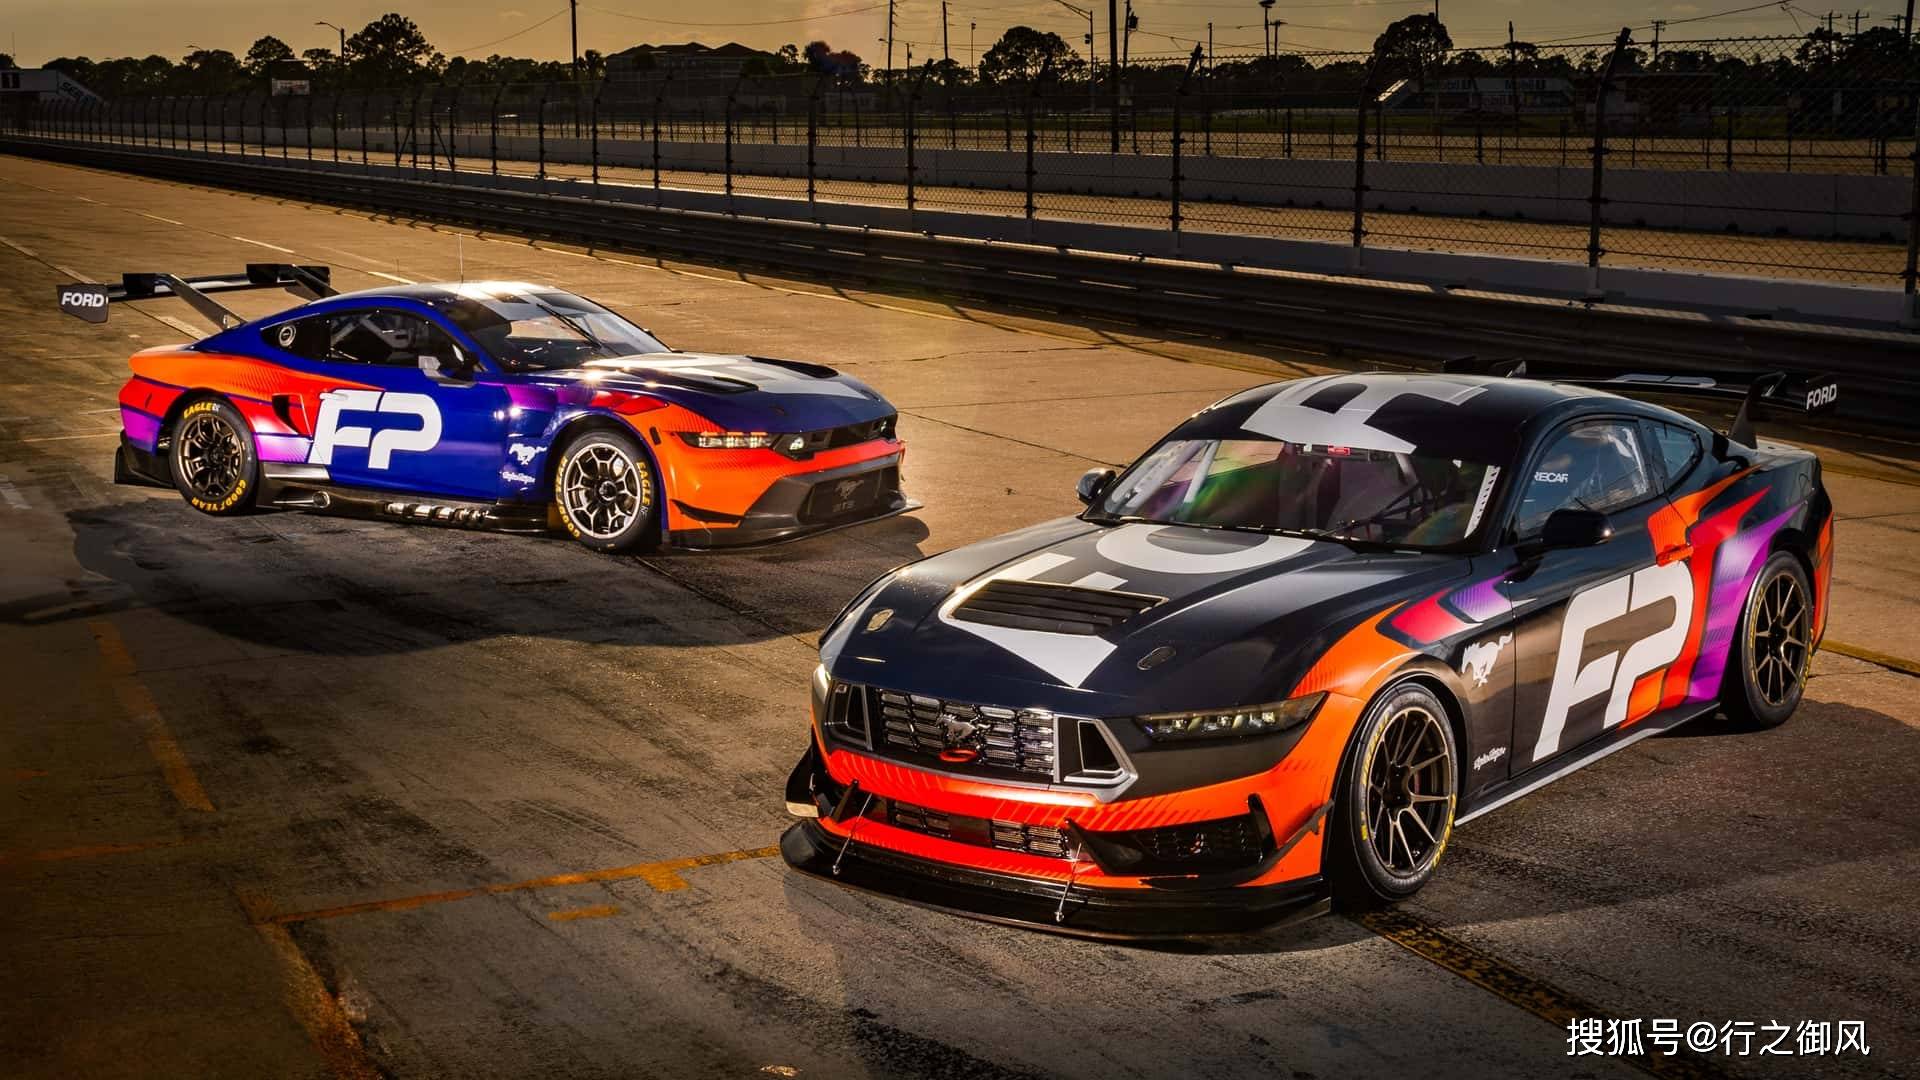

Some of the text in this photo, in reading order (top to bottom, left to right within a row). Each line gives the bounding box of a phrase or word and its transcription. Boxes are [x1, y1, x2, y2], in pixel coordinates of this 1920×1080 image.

[61, 292, 104, 307] FORD
[1806, 383, 1837, 410] FORD
[308, 389, 442, 470] FP
[636, 462, 651, 506] EAGLE
[1533, 560, 1693, 762] FP
